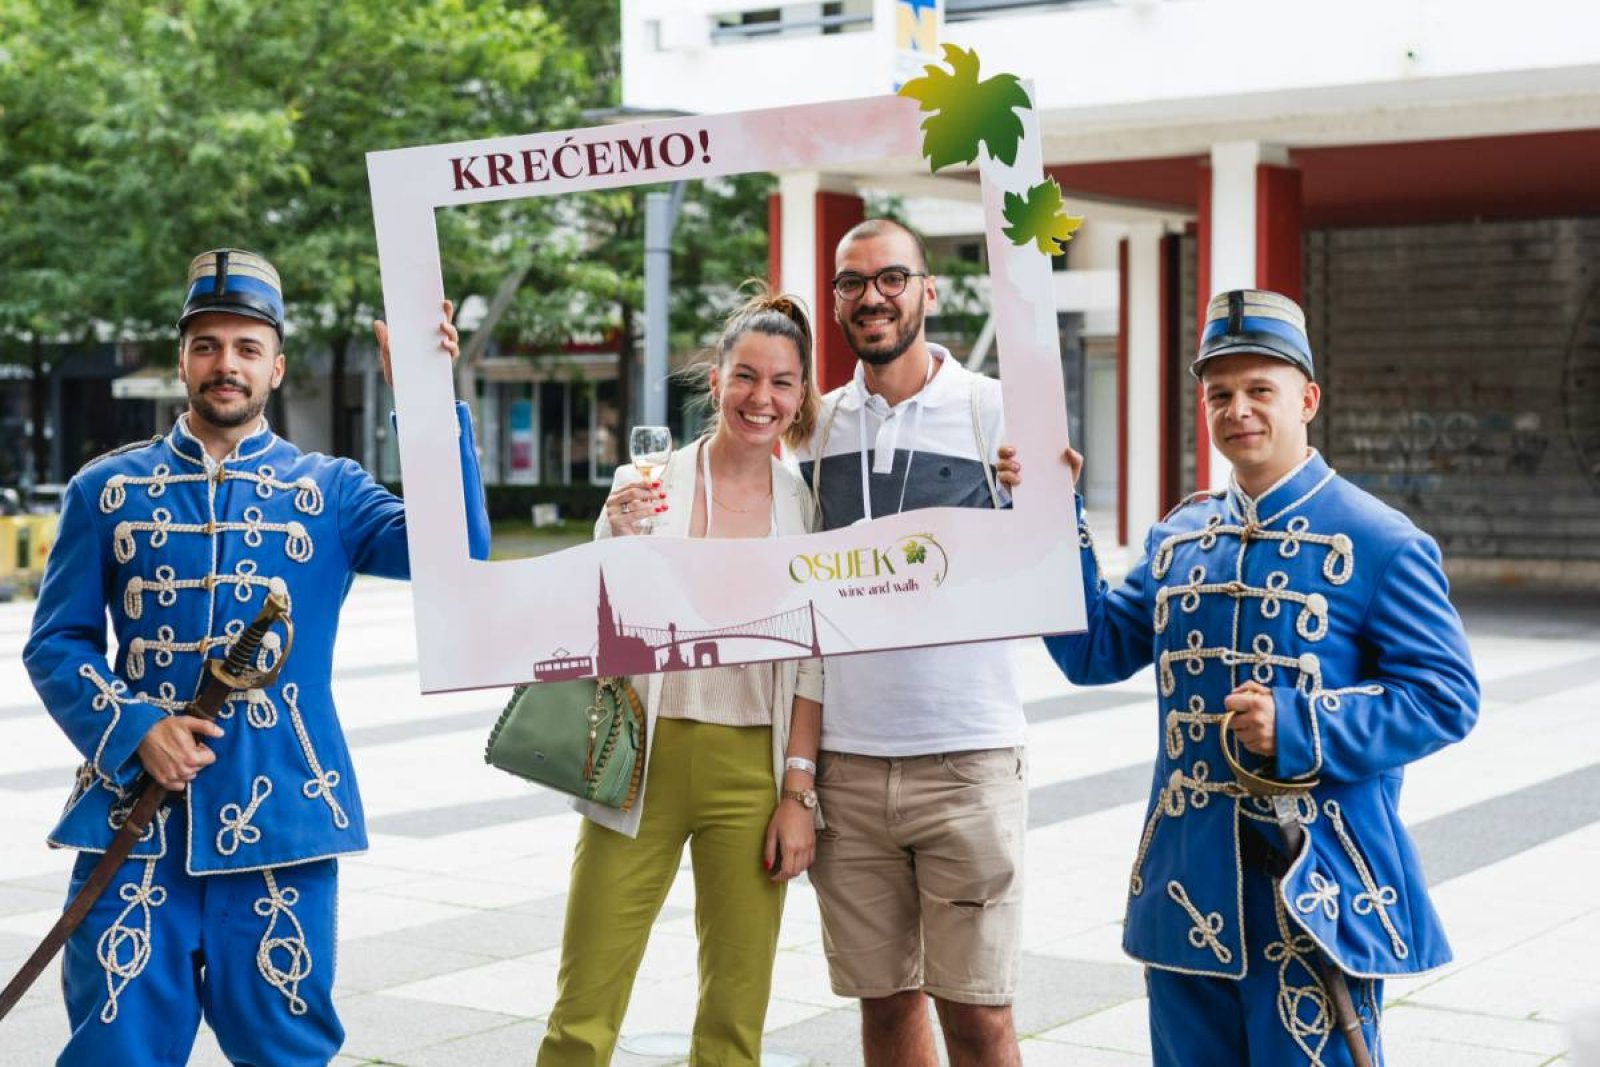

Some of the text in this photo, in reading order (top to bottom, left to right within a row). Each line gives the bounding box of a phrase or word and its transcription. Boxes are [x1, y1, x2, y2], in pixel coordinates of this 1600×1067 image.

[449, 129, 711, 191] KREĆEMO!
[788, 546, 896, 584] OSIJEK
[838, 585, 865, 598] wine
[868, 581, 890, 595] and
